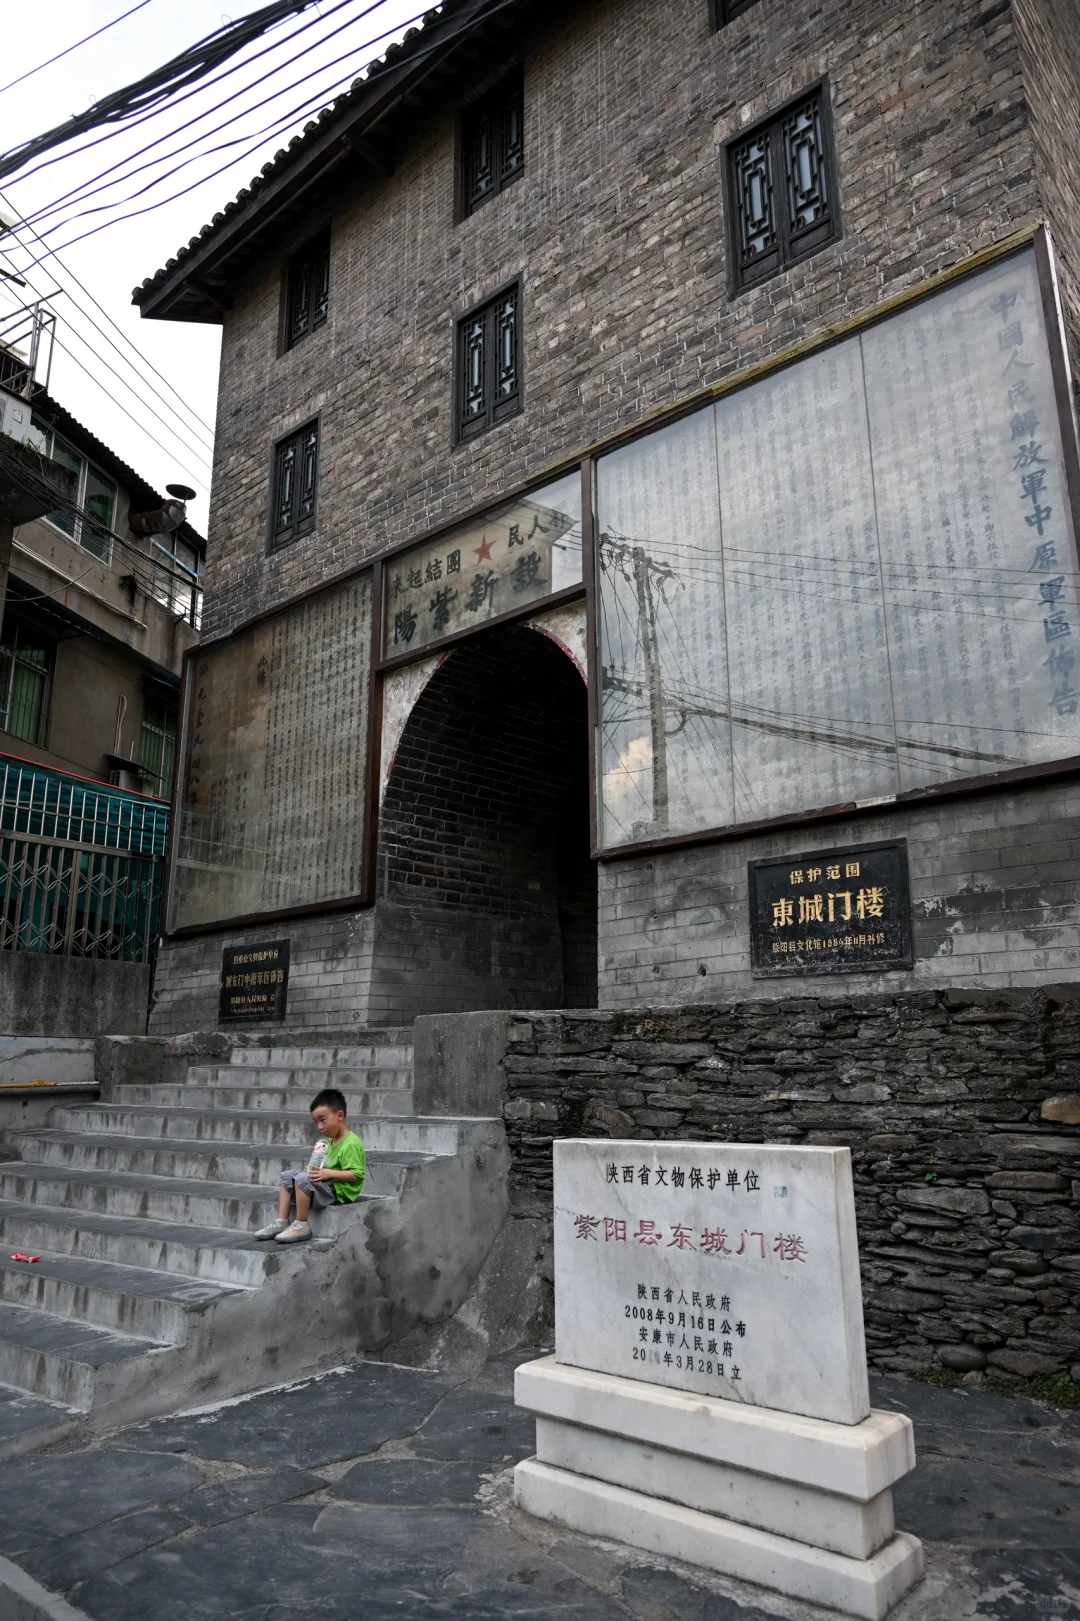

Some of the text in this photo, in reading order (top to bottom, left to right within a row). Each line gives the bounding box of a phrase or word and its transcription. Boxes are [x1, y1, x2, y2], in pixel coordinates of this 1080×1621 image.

[789, 862, 861, 885] 保护范围
[771, 886, 885, 927] 東城门楼
[605, 1162, 761, 1193] 陕西省文物保护单位
[573, 1213, 809, 1264] 紫阳县东城门楼
[637, 1283, 731, 1313] 陕西省人民政府
[624, 1304, 747, 1339] 2008年9月16日公布
[639, 1325, 734, 1358] 安康市人民政府
